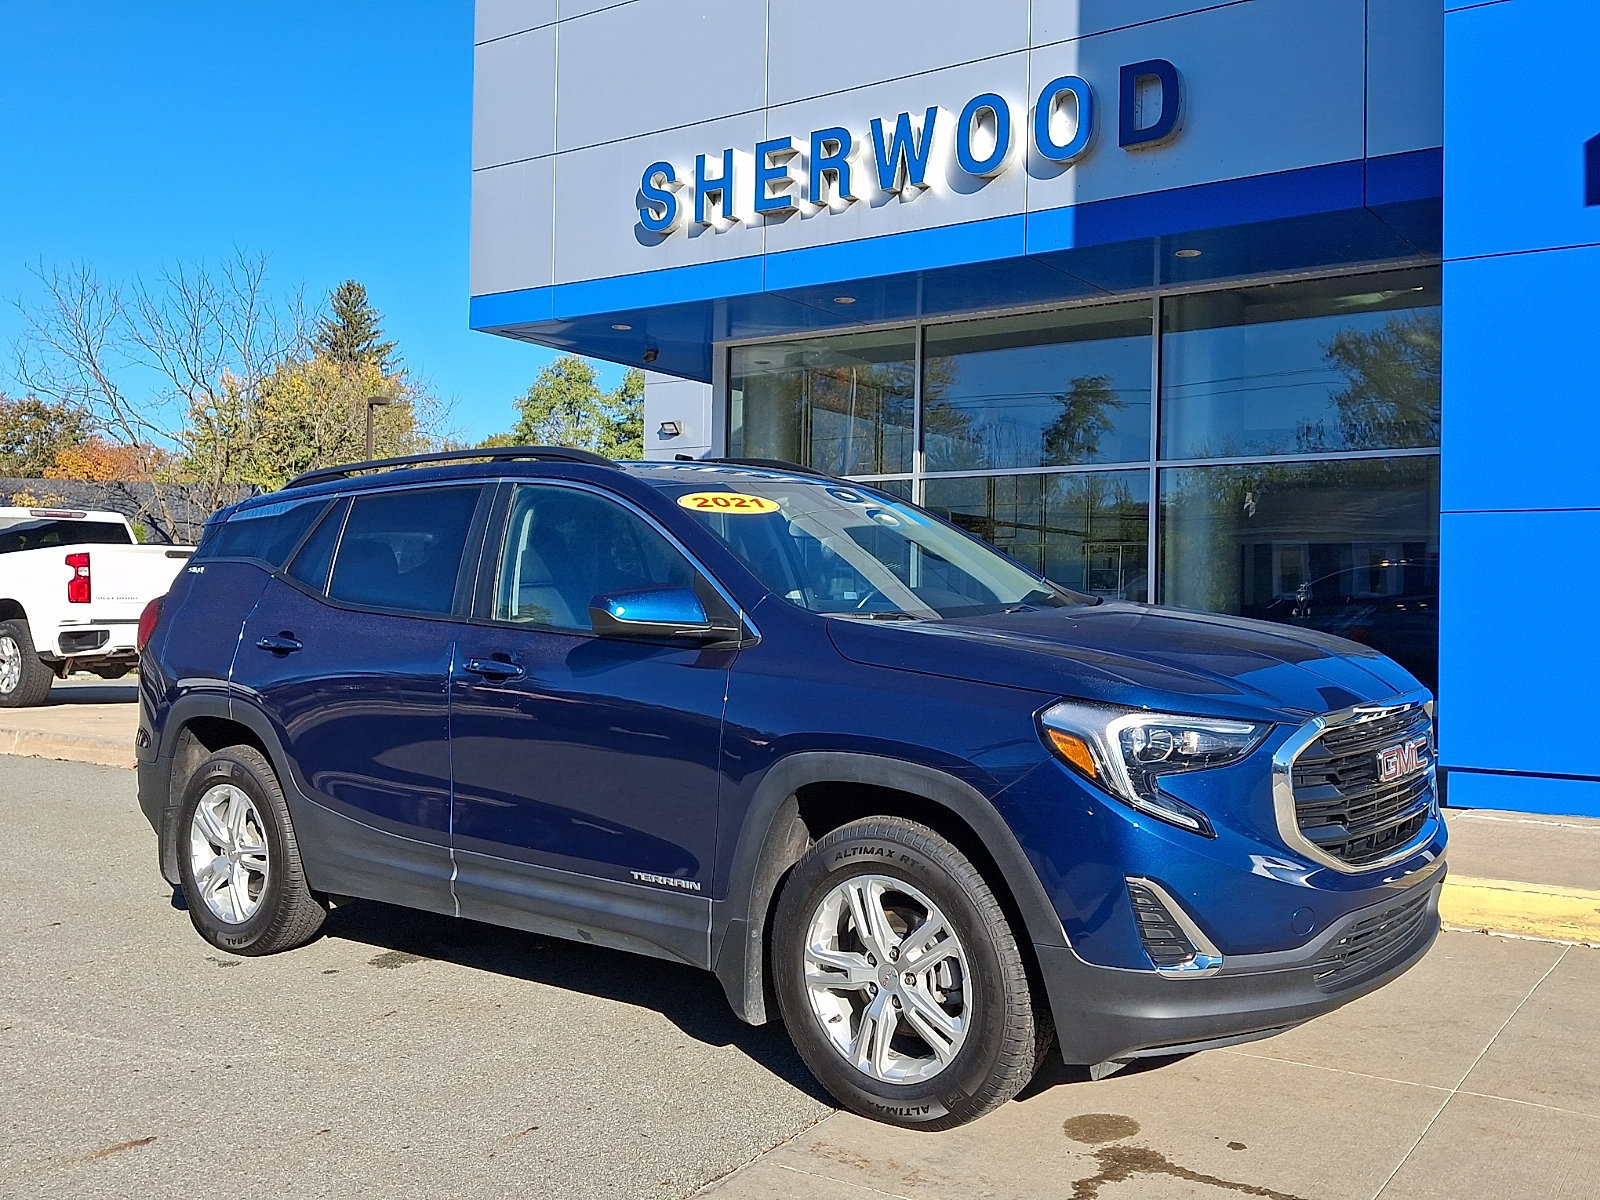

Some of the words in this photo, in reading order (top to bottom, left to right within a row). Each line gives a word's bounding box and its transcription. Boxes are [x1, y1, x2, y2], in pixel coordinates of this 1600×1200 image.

[638, 57, 1184, 235] SHERWOOD
[691, 496, 765, 509] 2021
[1376, 734, 1429, 783] GMC
[834, 845, 896, 862] ALTIMAX
[629, 869, 702, 892] TERRAIN
